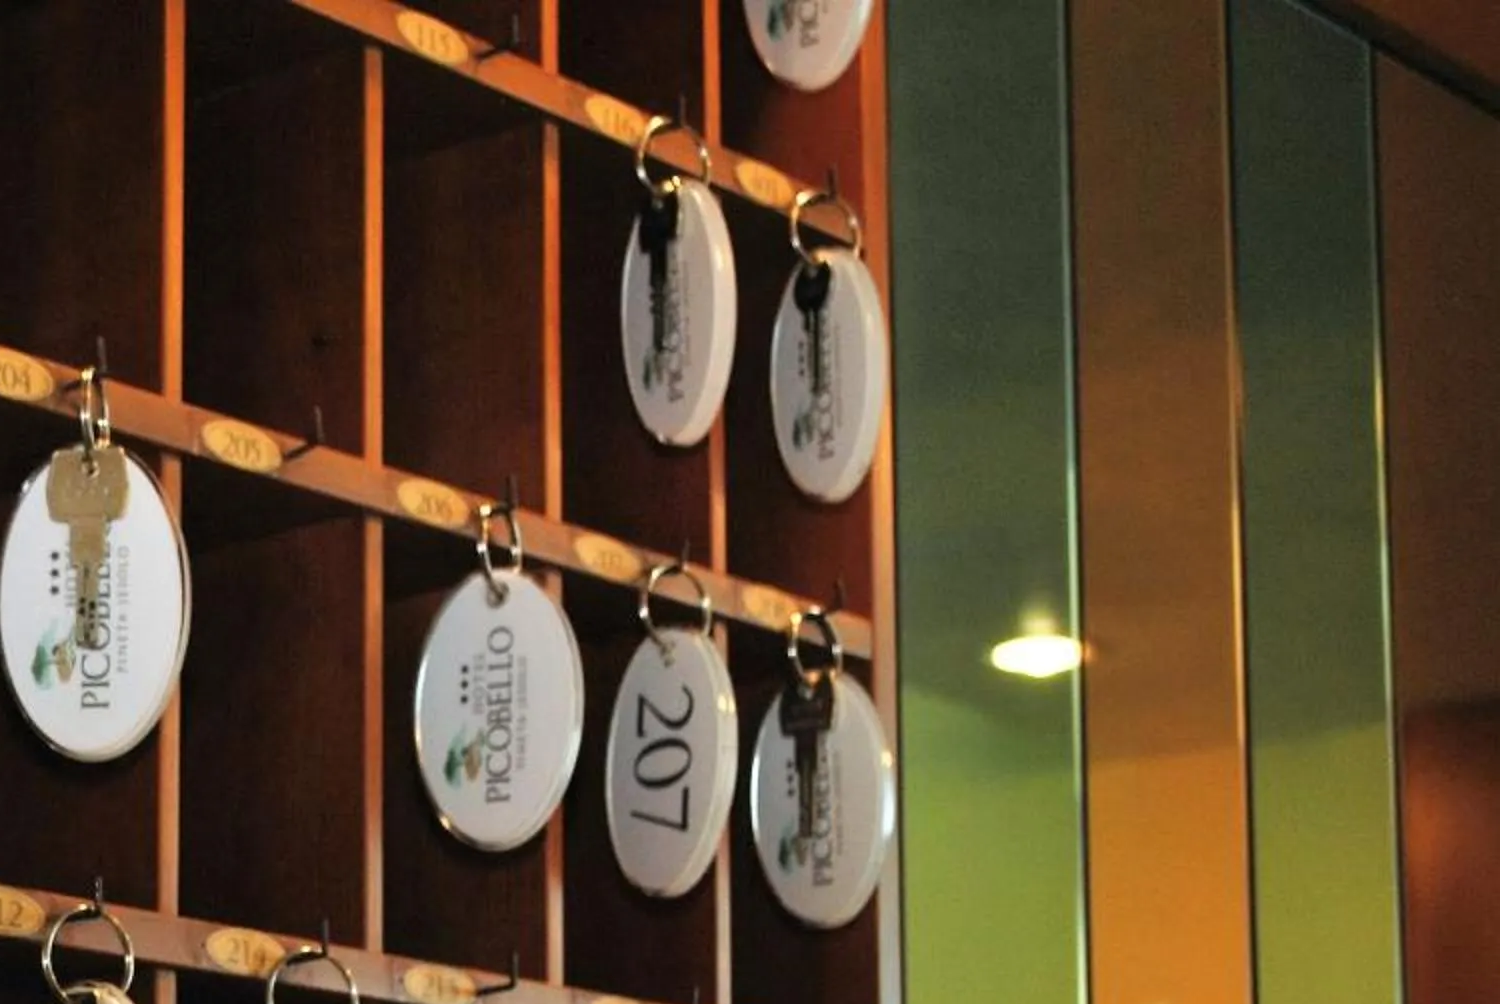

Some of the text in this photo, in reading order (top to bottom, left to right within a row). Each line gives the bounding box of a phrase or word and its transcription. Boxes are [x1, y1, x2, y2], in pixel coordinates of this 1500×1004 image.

[223, 431, 262, 462] 205
[484, 626, 514, 805] PICOBELLO
[630, 686, 695, 834] 207
